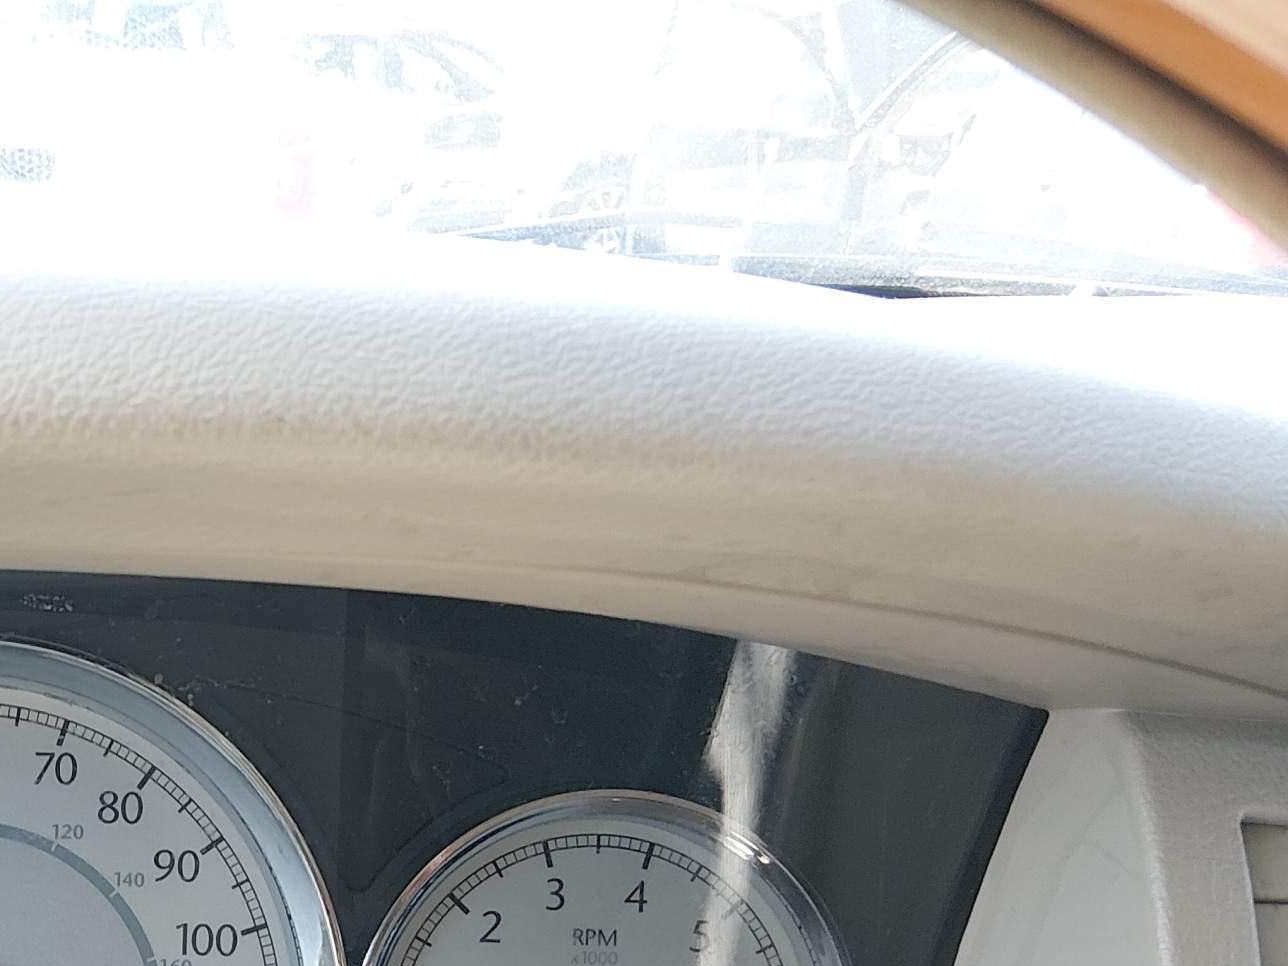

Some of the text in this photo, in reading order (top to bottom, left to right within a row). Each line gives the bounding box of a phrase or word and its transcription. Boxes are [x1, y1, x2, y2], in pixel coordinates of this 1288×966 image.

[35, 752, 78, 785] 70
[98, 791, 143, 824] 80
[52, 824, 84, 841] 120
[114, 872, 145, 888] 140
[154, 849, 200, 882] 90
[545, 879, 565, 911] 3
[624, 881, 648, 913] 4
[175, 923, 237, 957] 100
[479, 911, 501, 943] 2
[572, 929, 617, 947] RPM
[689, 920, 710, 952] 5
[571, 951, 618, 965] x1000
